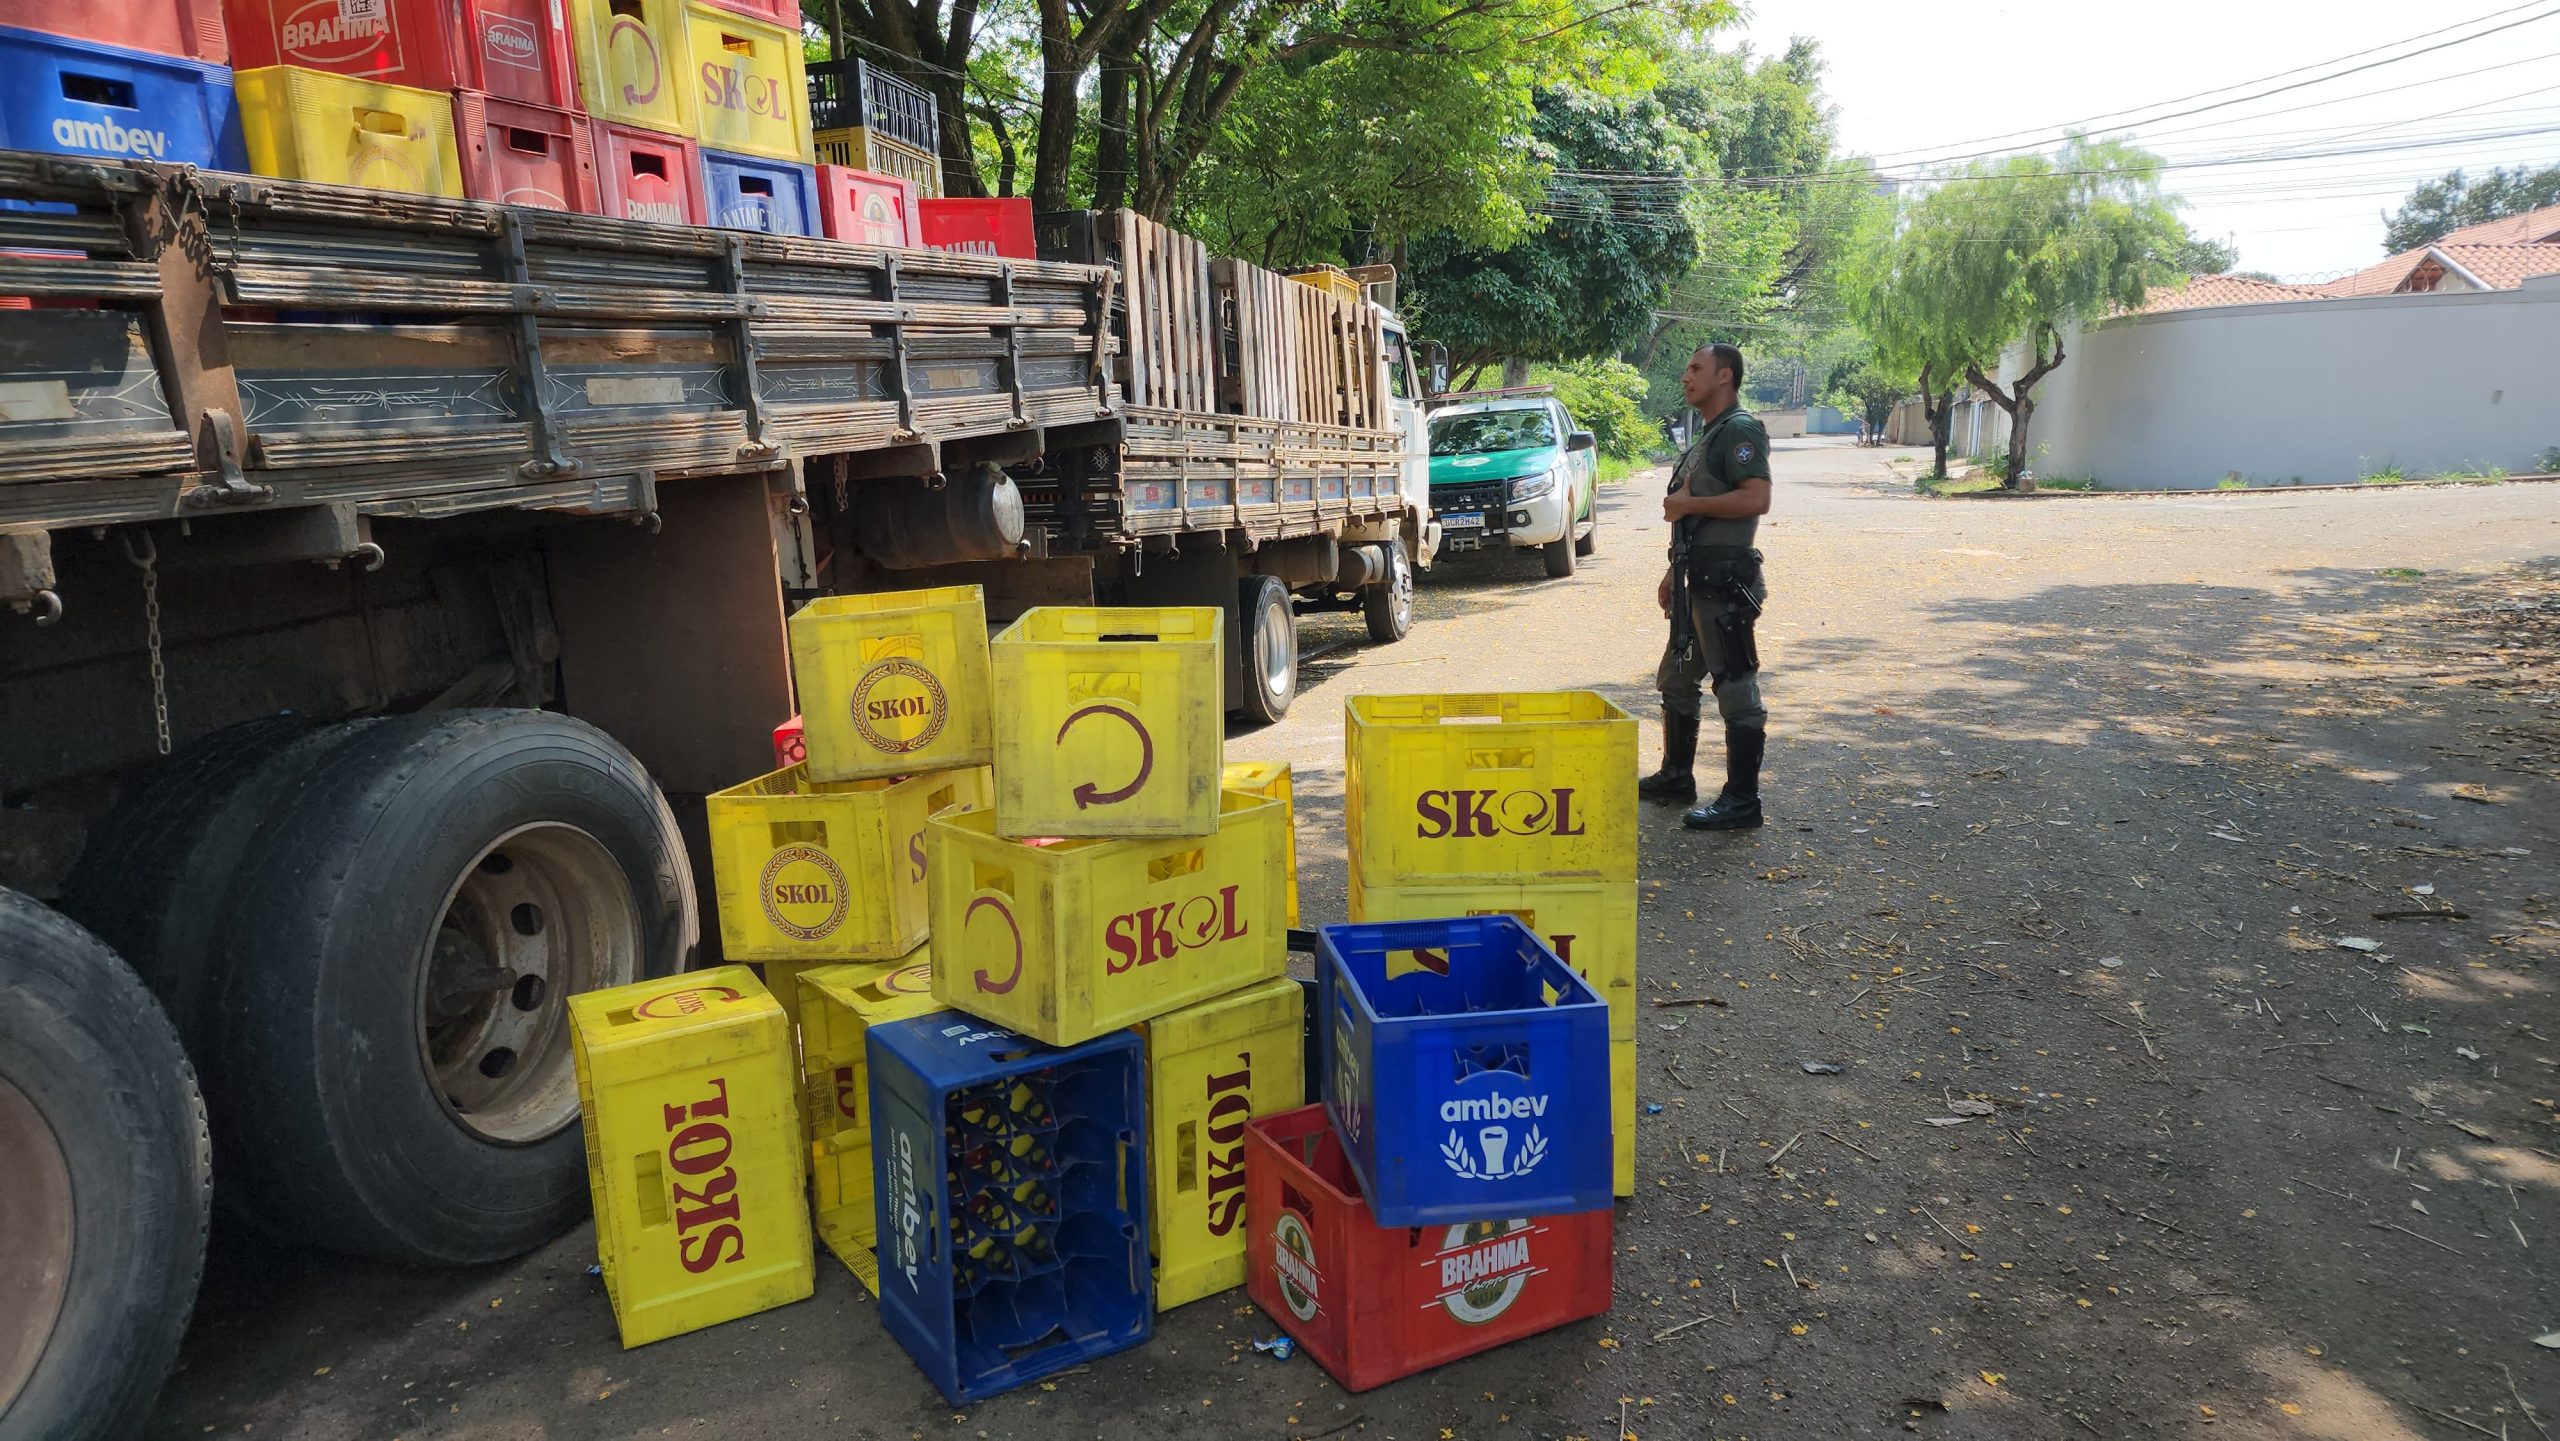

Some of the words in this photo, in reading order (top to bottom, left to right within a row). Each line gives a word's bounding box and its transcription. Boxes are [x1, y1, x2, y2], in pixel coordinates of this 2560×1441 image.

[282, 15, 391, 50] BRAHMA
[487, 30, 536, 53] BRAHMA
[52, 115, 165, 157] ambev
[867, 696, 931, 721] SKOL
[775, 884, 834, 905] SKOL
[1440, 1090, 1549, 1123] ambev
[1206, 1051, 1252, 1237] SKOL
[662, 1077, 746, 1274] SKOL
[900, 1131, 922, 1296] ambev
[1275, 1241, 1319, 1299] BRAHMA
[1441, 1236, 1530, 1288] BRAHMA
